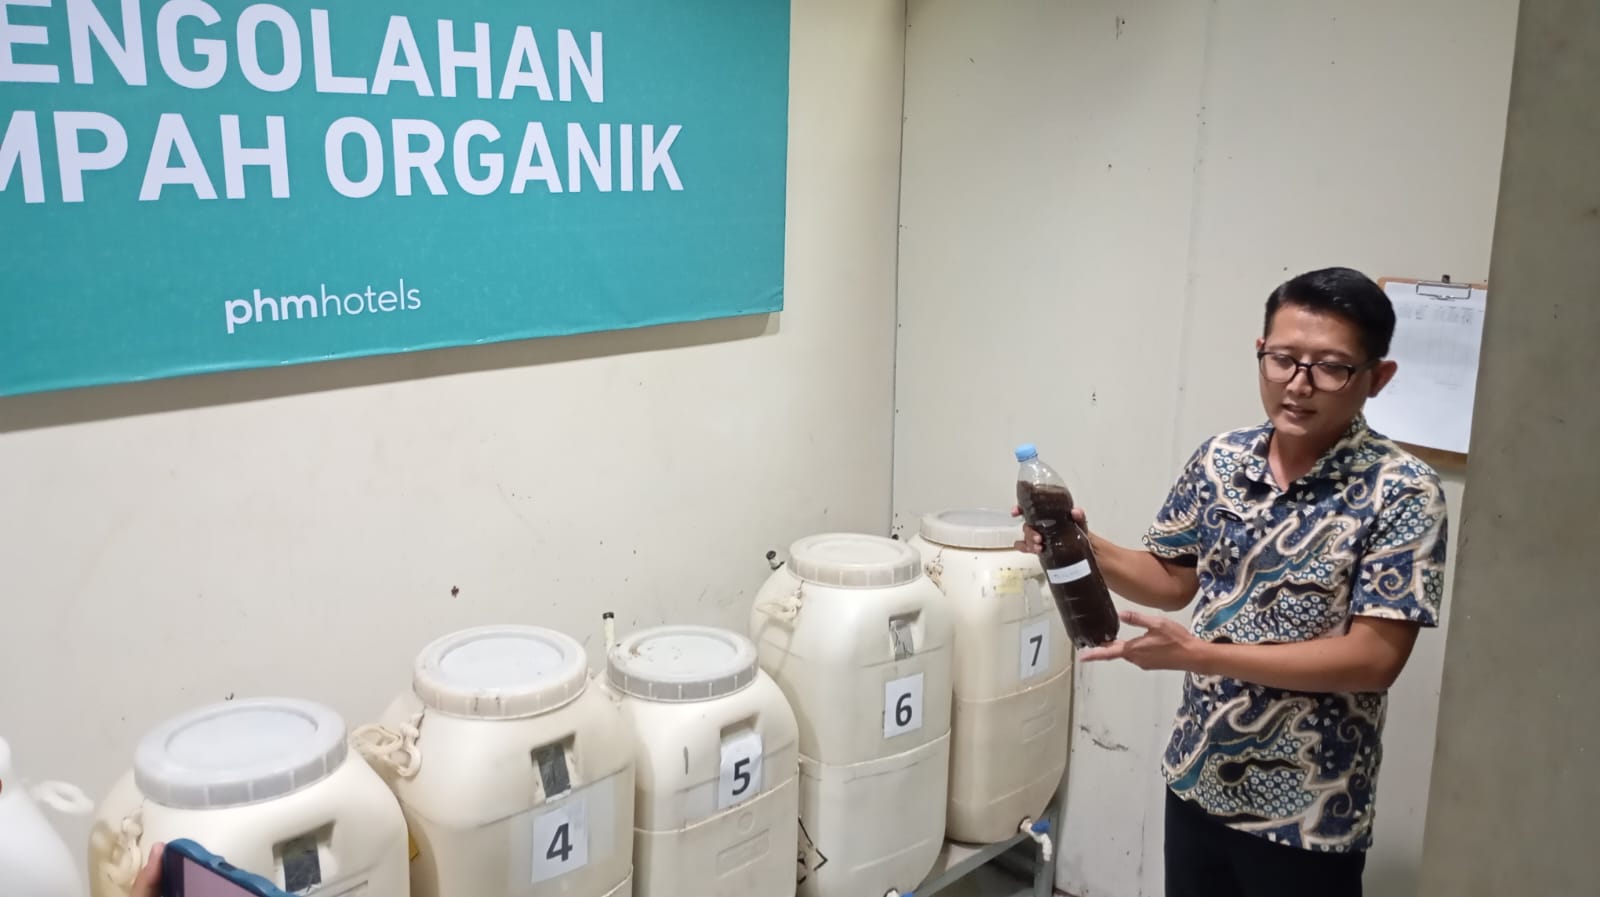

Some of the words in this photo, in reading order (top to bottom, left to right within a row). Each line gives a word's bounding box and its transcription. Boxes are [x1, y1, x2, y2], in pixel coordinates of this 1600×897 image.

[0, 0, 604, 104] ENGOLAHAN
[324, 116, 684, 199] ORGANIK
[224, 278, 422, 335] phmhotels
[1029, 634, 1043, 667] 7
[895, 692, 913, 727] 6
[731, 757, 751, 796] 5
[546, 822, 573, 862] 4
